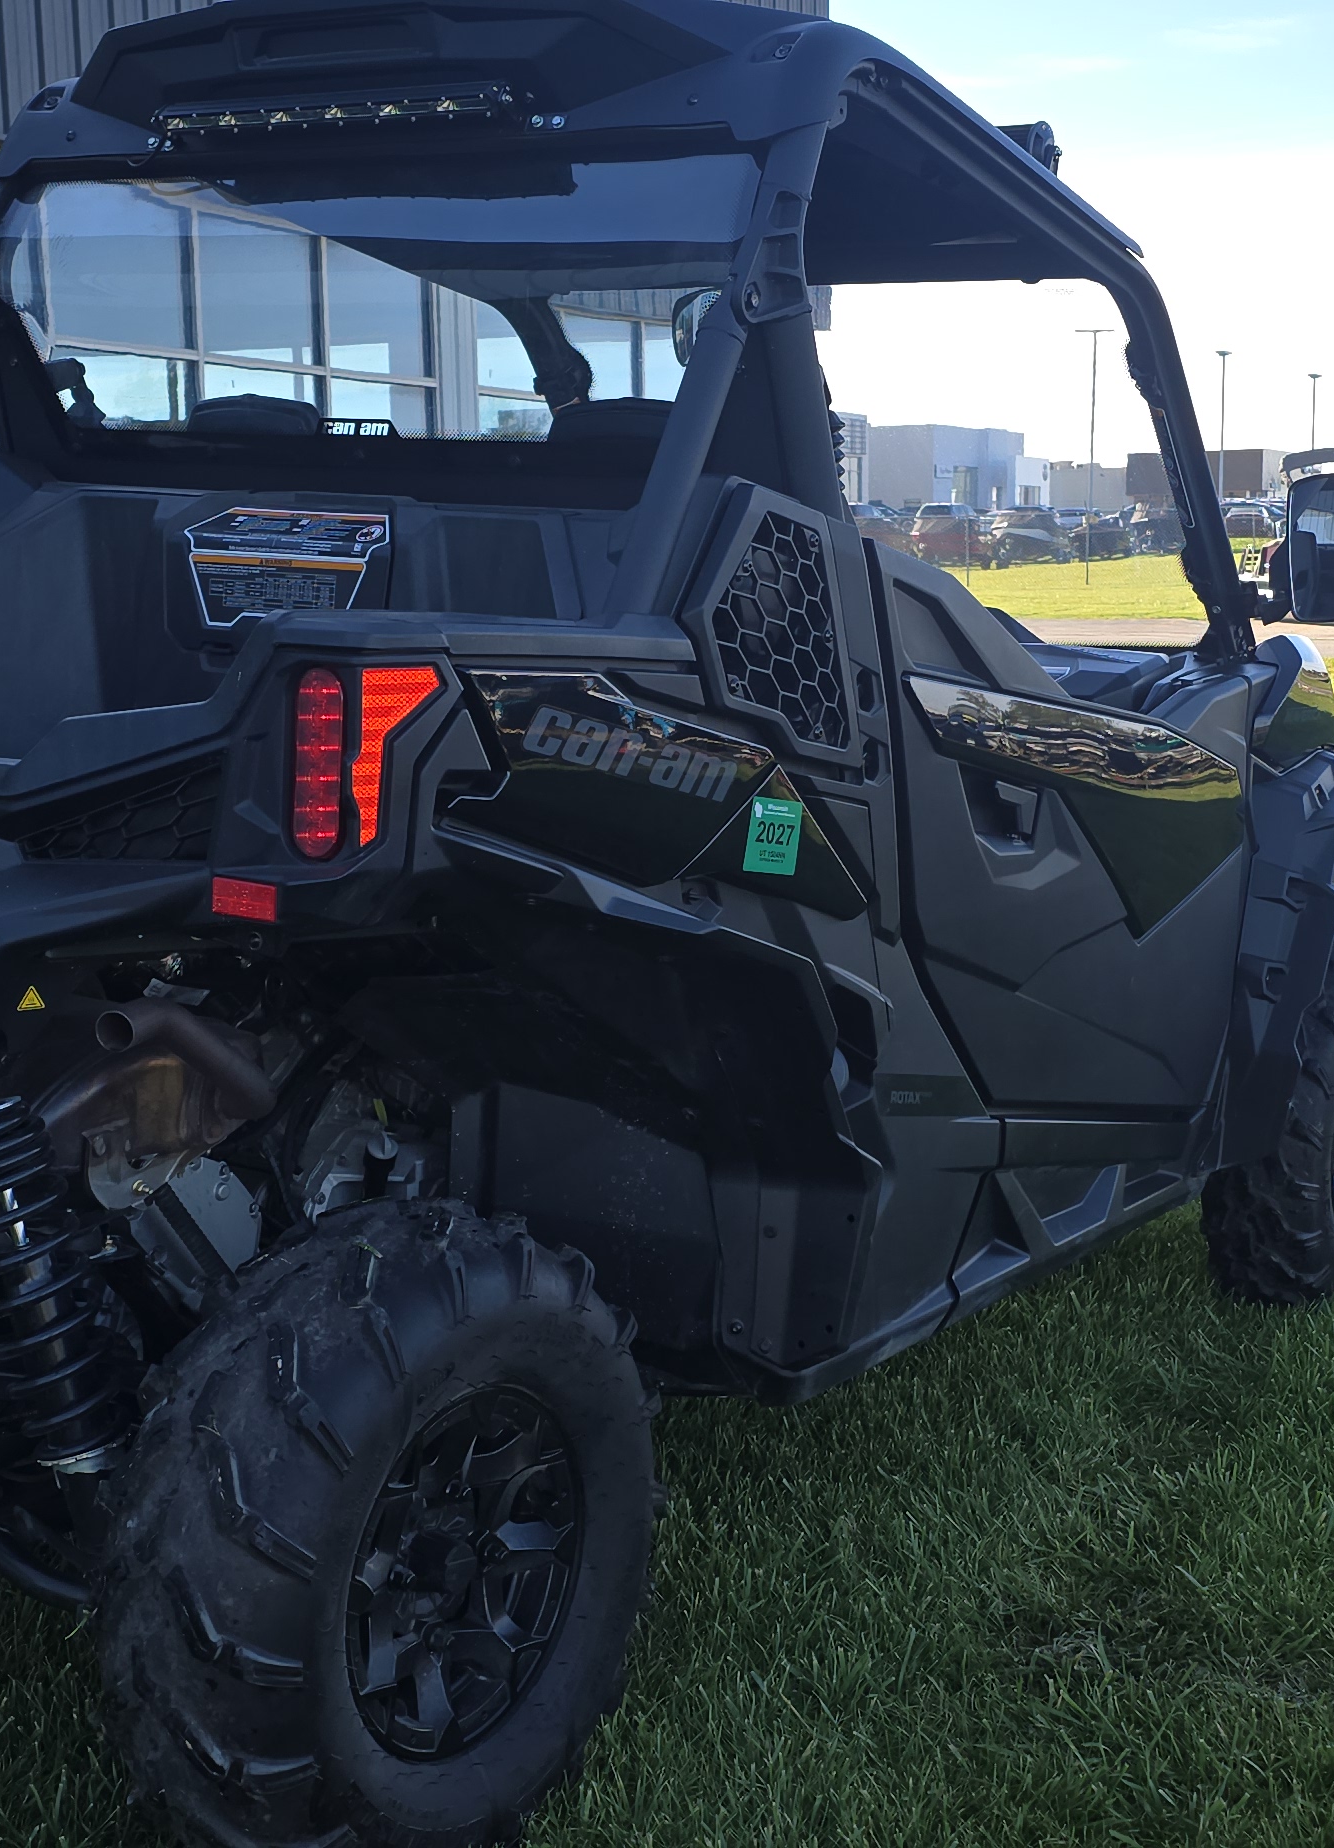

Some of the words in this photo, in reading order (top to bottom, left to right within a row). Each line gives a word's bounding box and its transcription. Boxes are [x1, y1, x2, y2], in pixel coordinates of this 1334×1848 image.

[322, 422, 355, 435] can
[359, 422, 389, 436] am
[523, 706, 737, 802] can-am
[755, 820, 795, 847] 2027
[890, 1090, 921, 1104] ROTAX
